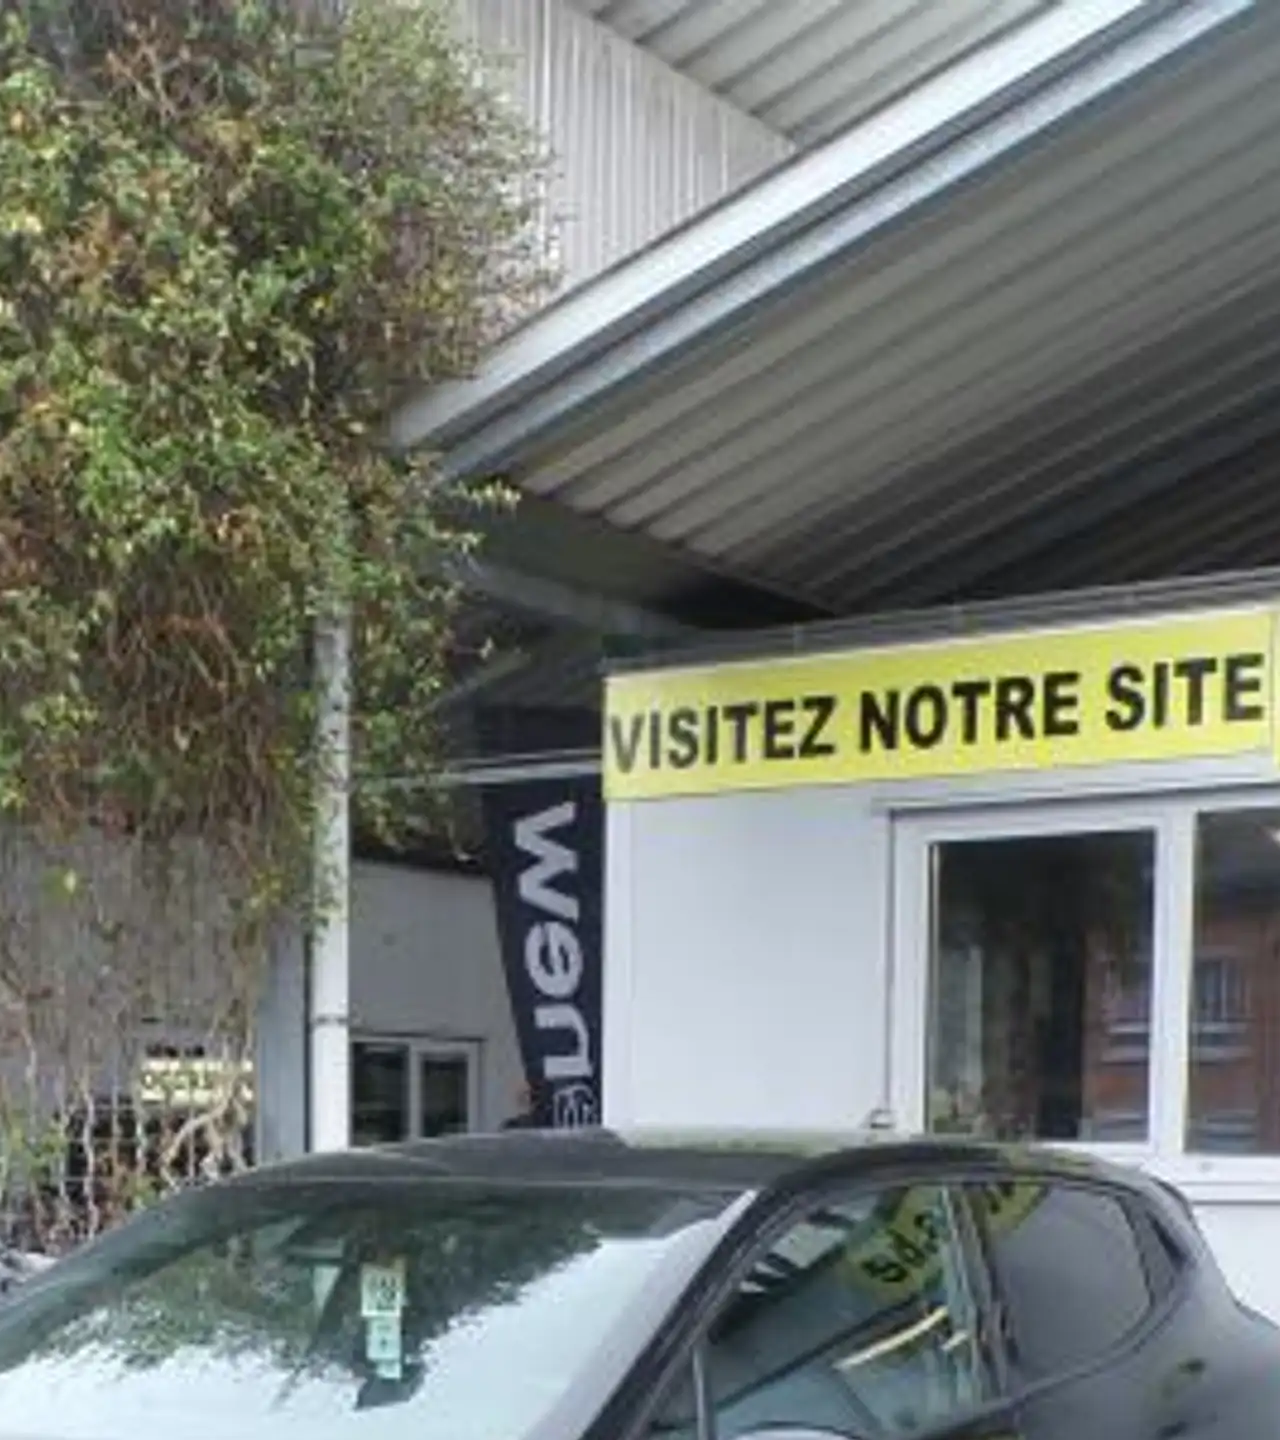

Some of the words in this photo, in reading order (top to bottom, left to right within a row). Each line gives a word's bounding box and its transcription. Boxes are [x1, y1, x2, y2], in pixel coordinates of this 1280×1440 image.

[610, 695, 838, 773] VISITEZ
[858, 671, 1080, 753] NOTRE
[1104, 652, 1265, 731] SITE
